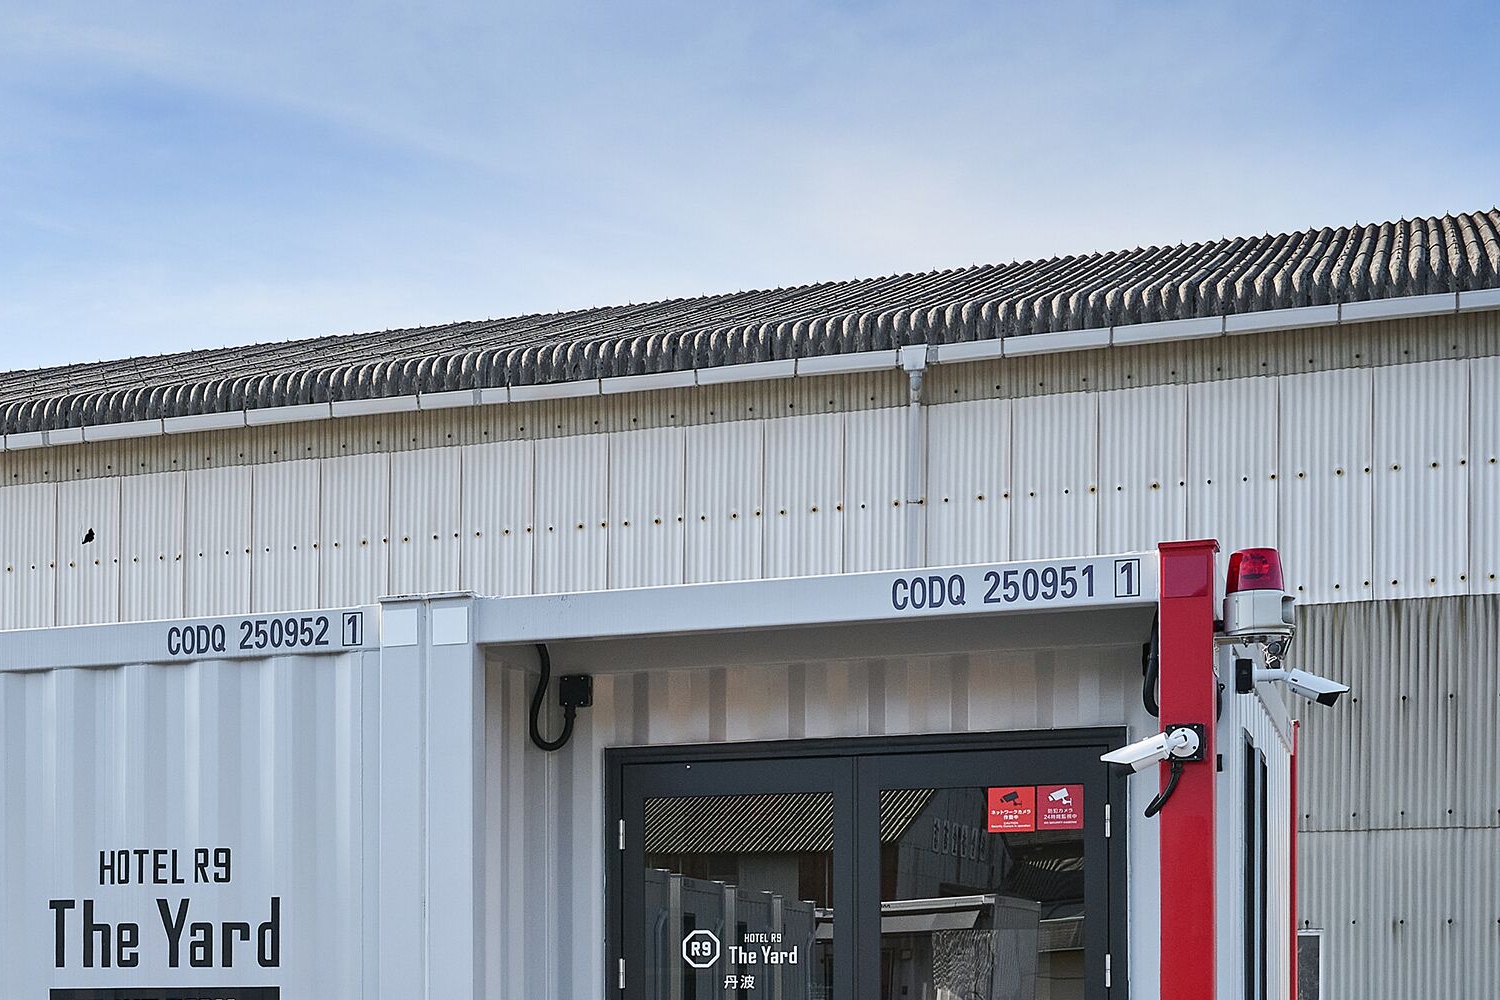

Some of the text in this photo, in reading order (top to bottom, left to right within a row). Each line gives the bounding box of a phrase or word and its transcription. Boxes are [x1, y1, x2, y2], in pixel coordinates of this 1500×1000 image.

[892, 561, 1136, 611] CODQ 250951 1
[167, 614, 359, 656] CODQ 250952 1
[99, 848, 231, 885] HOTEL R9
[49, 896, 280, 968] The Yard
[744, 933, 782, 943] HOTEL R9
[690, 941, 712, 957] R9
[728, 945, 798, 964] The Yard
[723, 974, 755, 990] 丹波
